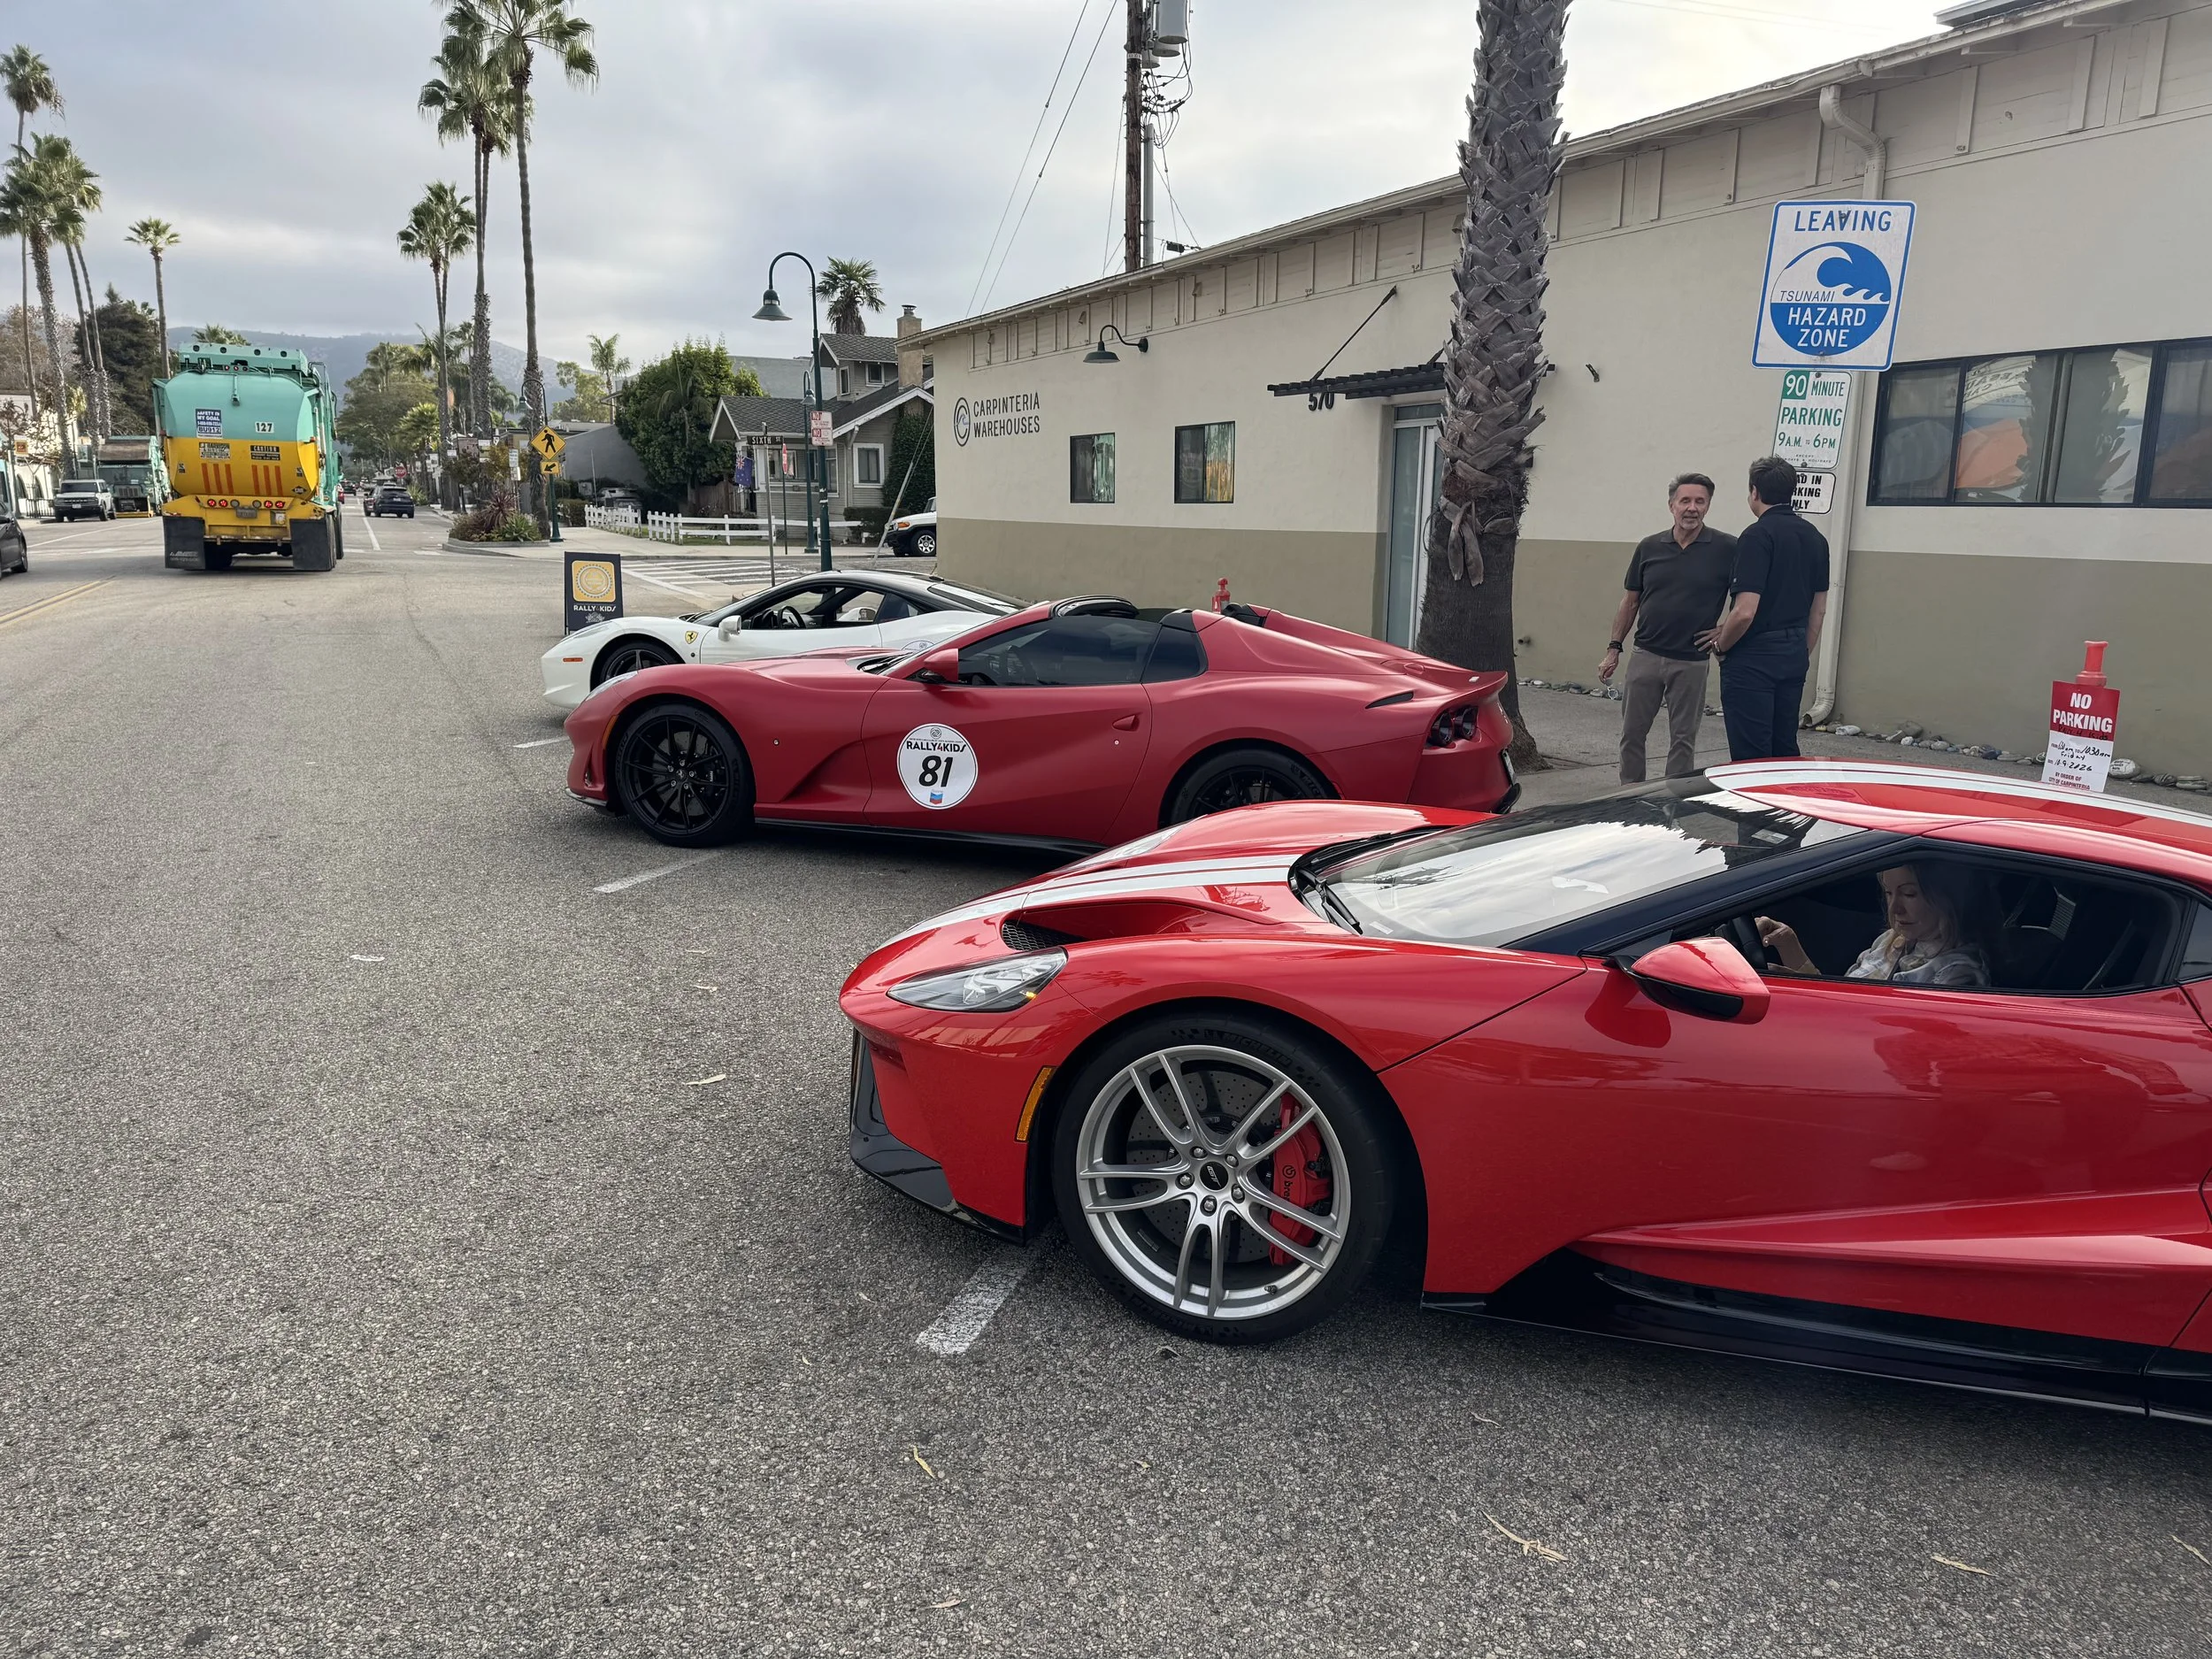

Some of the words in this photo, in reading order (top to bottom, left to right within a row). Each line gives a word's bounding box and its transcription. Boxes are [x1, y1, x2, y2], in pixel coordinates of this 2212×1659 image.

[1794, 210, 1892, 232] LEAVING
[1780, 290, 1835, 302] TSUNAMI
[1787, 307, 1866, 326] HAZARD
[1797, 328, 1849, 348] ZONE
[1786, 374, 1807, 396] 90
[1810, 380, 1846, 397] MINUTE
[973, 391, 1040, 418] CARPINTERIA
[1308, 392, 1334, 411] 570
[1780, 407, 1843, 426] PARKING
[257, 423, 273, 432] 127
[973, 415, 1040, 438] WAREHOUSES
[1811, 475, 1822, 485] IN
[1793, 488, 1821, 497] RKING
[1792, 499, 1810, 510] NLY
[2070, 692, 2092, 710] NO
[2053, 709, 2113, 733] PARKING
[906, 741, 967, 753] RALLY4KIDS
[918, 755, 954, 787] 81
[2060, 780, 2091, 790] CARPINTERIA
